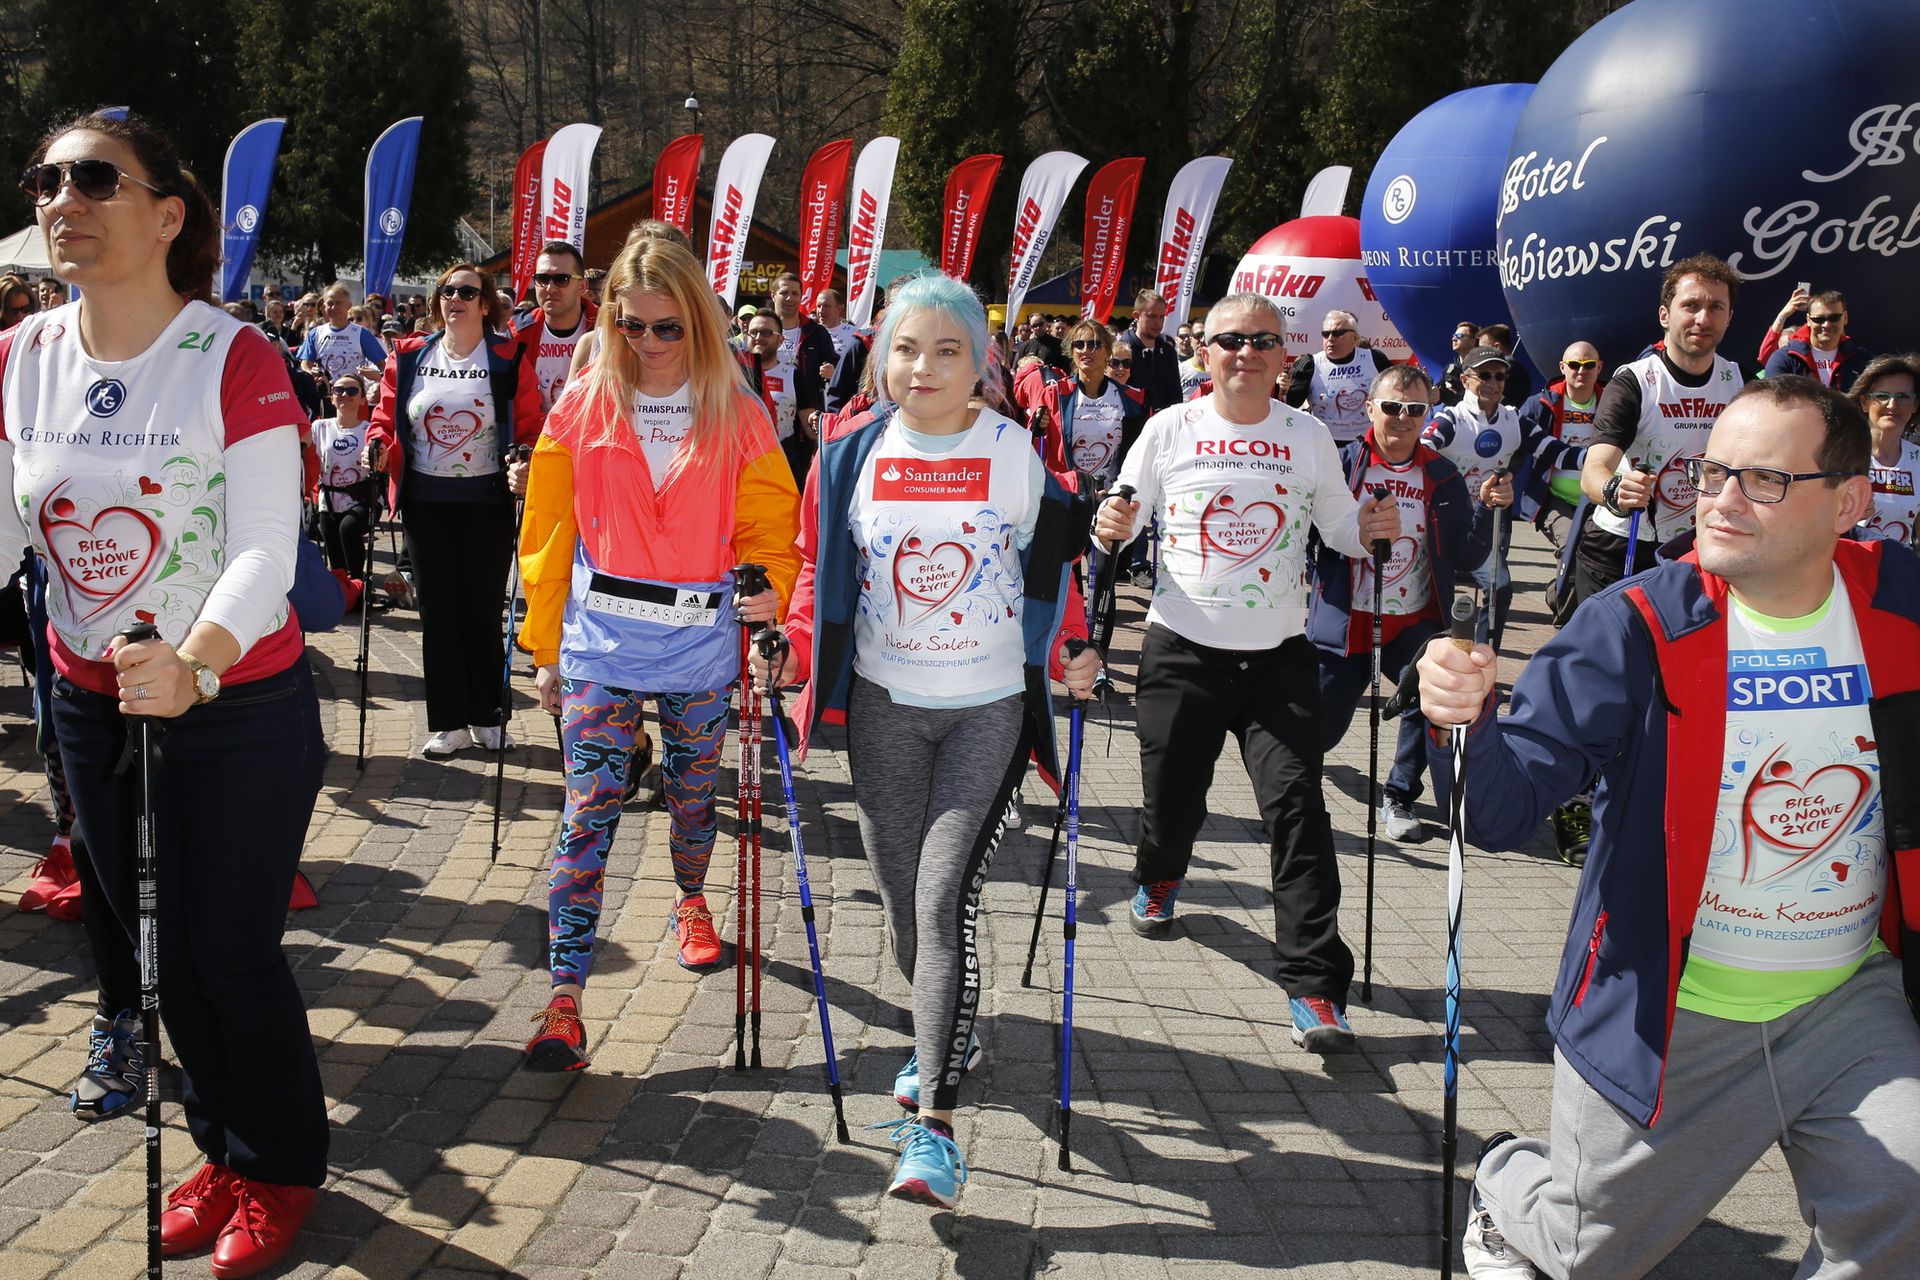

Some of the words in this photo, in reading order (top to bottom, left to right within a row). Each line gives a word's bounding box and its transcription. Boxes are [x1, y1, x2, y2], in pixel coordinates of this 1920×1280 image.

[1496, 136, 1607, 229] Hotel
[546, 177, 572, 239] AKO
[828, 200, 838, 234] BANK
[514, 173, 541, 274] Santander
[574, 207, 584, 229] PBG
[712, 184, 744, 294] RAFAKO
[803, 181, 828, 283] Santander
[850, 188, 877, 302] RAFAKO
[1083, 195, 1114, 296] Santander
[1496, 215, 1682, 291] ołębiewski
[821, 235, 836, 282] CONSUMER
[1018, 255, 1037, 289] GRUPA
[1033, 229, 1048, 252] PBG
[1104, 242, 1120, 297] CONSUMER
[1115, 216, 1126, 242] BANK
[1361, 250, 1391, 267] DEON
[1398, 247, 1499, 267] RICHTER
[1235, 264, 1326, 298] RAFAKO
[540, 344, 576, 358] SMOPO
[430, 368, 488, 379] PLAYBO
[1329, 365, 1362, 377] AWOS
[1720, 370, 1733, 381] 38
[1674, 422, 1698, 430] GRUPA
[1699, 422, 1713, 430] PBG
[21, 427, 91, 445] GEDEON
[101, 430, 181, 446] RICHTER
[1195, 440, 1291, 461] RICOH
[904, 467, 982, 482] Santander
[1194, 458, 1247, 470] imagine.
[1250, 460, 1295, 475] change.
[1868, 470, 1912, 487] SUPER
[904, 486, 945, 494] CONSUMER
[947, 486, 967, 494] BANK
[1401, 501, 1415, 509] PBG
[1228, 521, 1256, 529] BIEG
[1235, 528, 1268, 538] NOWE
[79, 539, 117, 552] BIEG
[1226, 537, 1261, 547] ŻYCIE
[69, 558, 87, 569] PO
[92, 550, 140, 566] NOWE
[919, 563, 944, 573] BIEG
[82, 565, 129, 582] ŻYCIE
[910, 575, 927, 585] PO
[929, 570, 958, 583] NOWE
[918, 580, 950, 593] ŻYCIE
[680, 600, 702, 609] adidas
[885, 632, 922, 651] Nicole
[927, 635, 980, 651] Saleta
[886, 653, 897, 662] LAT
[907, 658, 970, 668] PRZESZCZEPIENIU
[971, 653, 991, 664] NERKI
[1732, 652, 1818, 668] POLSAT
[1732, 672, 1853, 706] SPORT
[1786, 795, 1825, 809] BIEG
[1769, 813, 1790, 825] PO
[1795, 803, 1844, 822] NOWE
[1782, 818, 1831, 837] ŻYCIE
[1698, 890, 1771, 920] Marcin
[1700, 917, 1730, 933] LATA
[1735, 925, 1751, 937] PO
[1756, 920, 1860, 941] PRZESZCZEPIENIU
